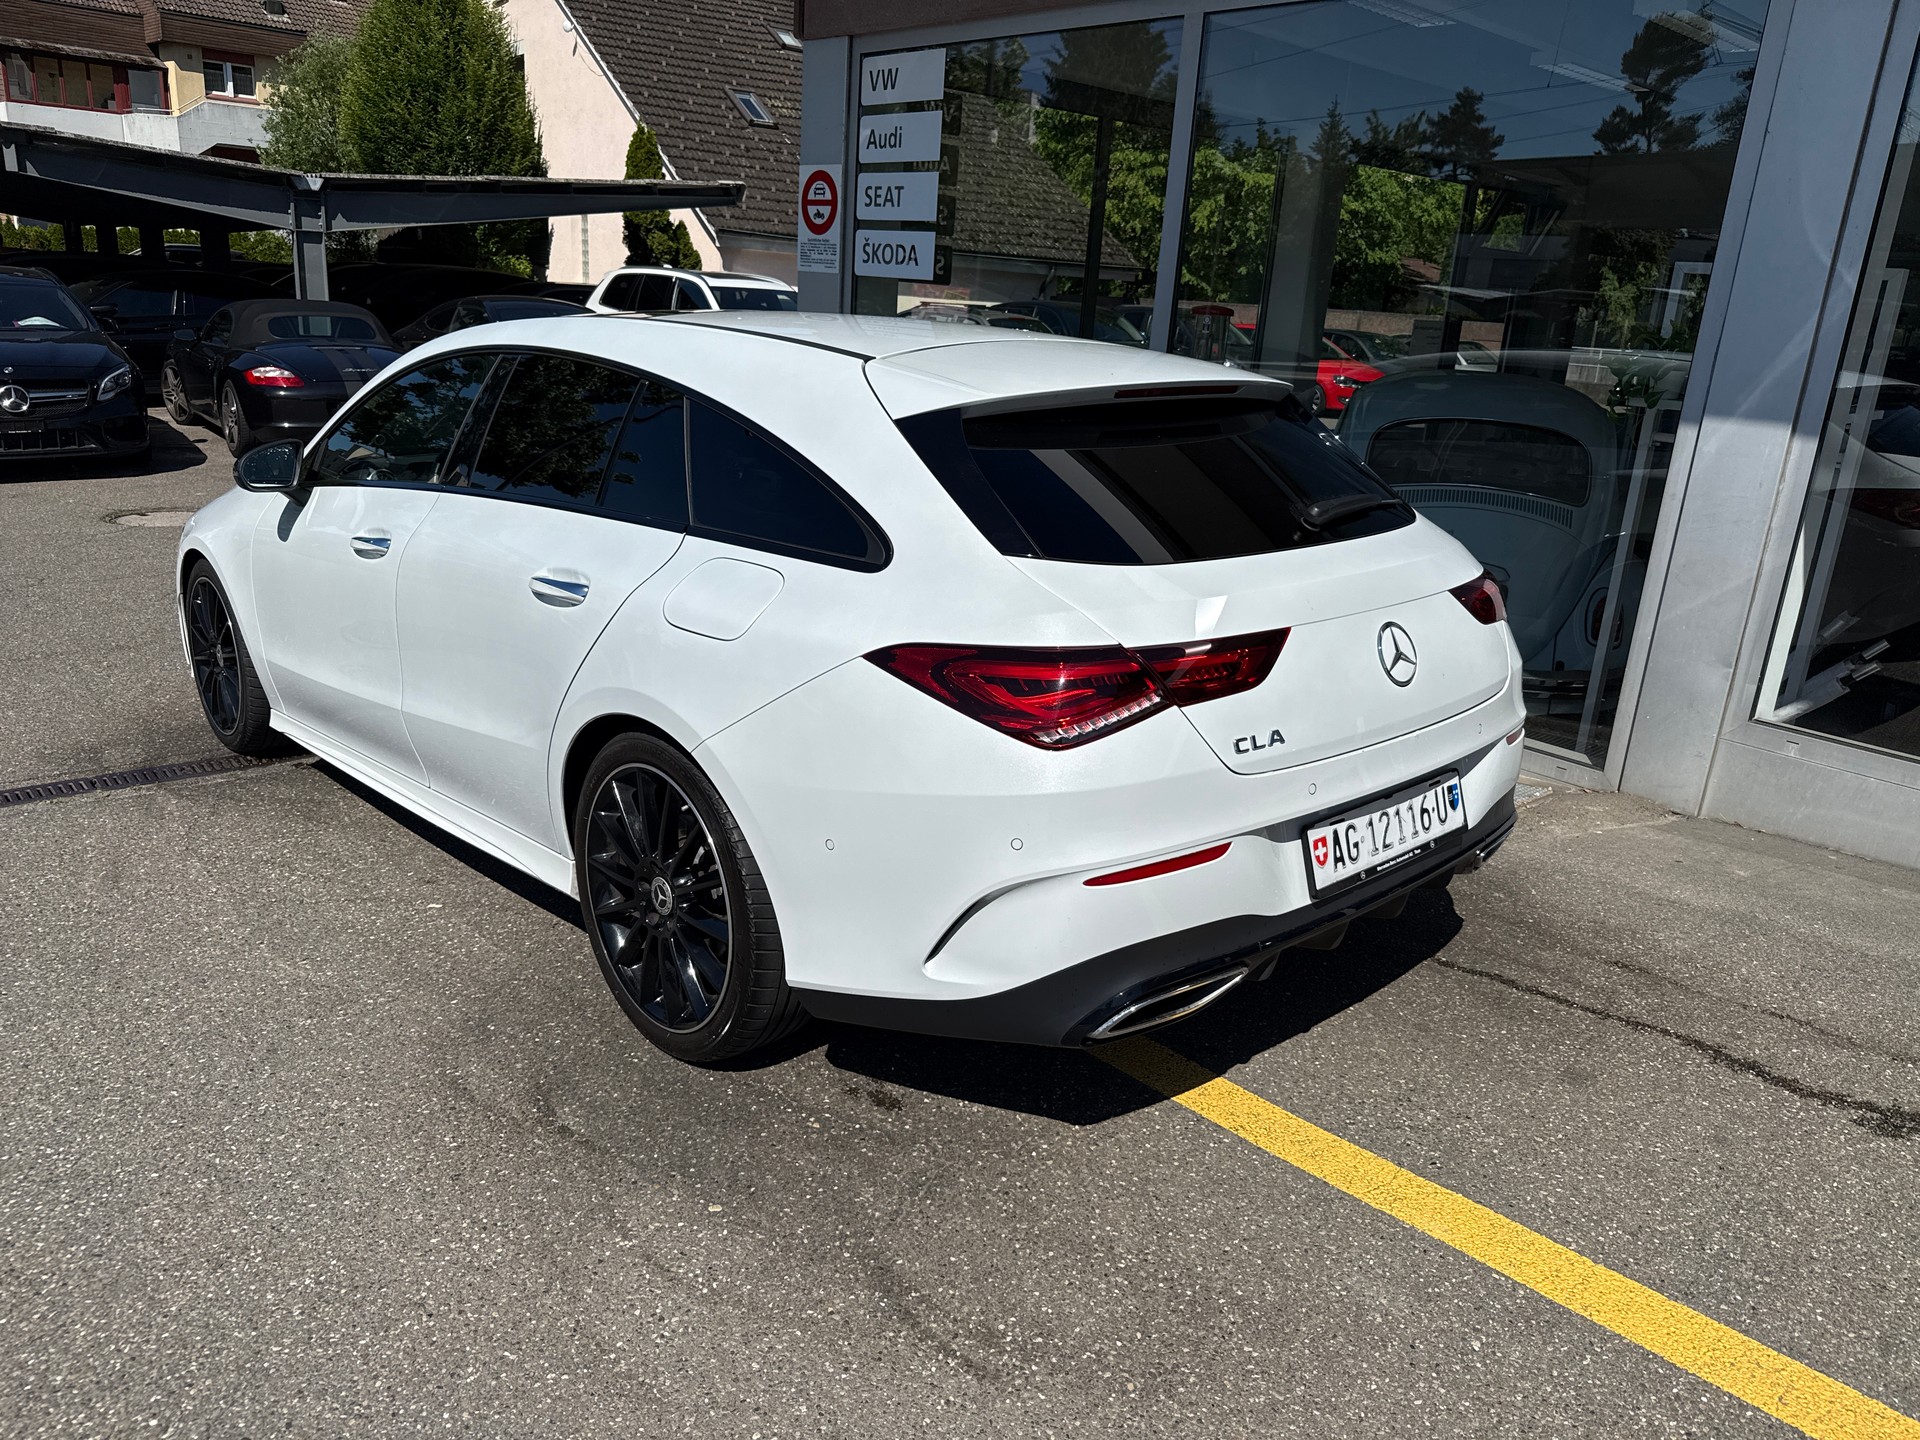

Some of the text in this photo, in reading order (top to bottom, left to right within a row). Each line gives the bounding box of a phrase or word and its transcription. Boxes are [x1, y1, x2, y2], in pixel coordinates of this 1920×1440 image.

[869, 68, 899, 91] VW
[866, 126, 903, 149] Audi
[864, 185, 905, 207] SEAT
[861, 237, 919, 266] ŠKODA
[1233, 729, 1285, 754] CLA
